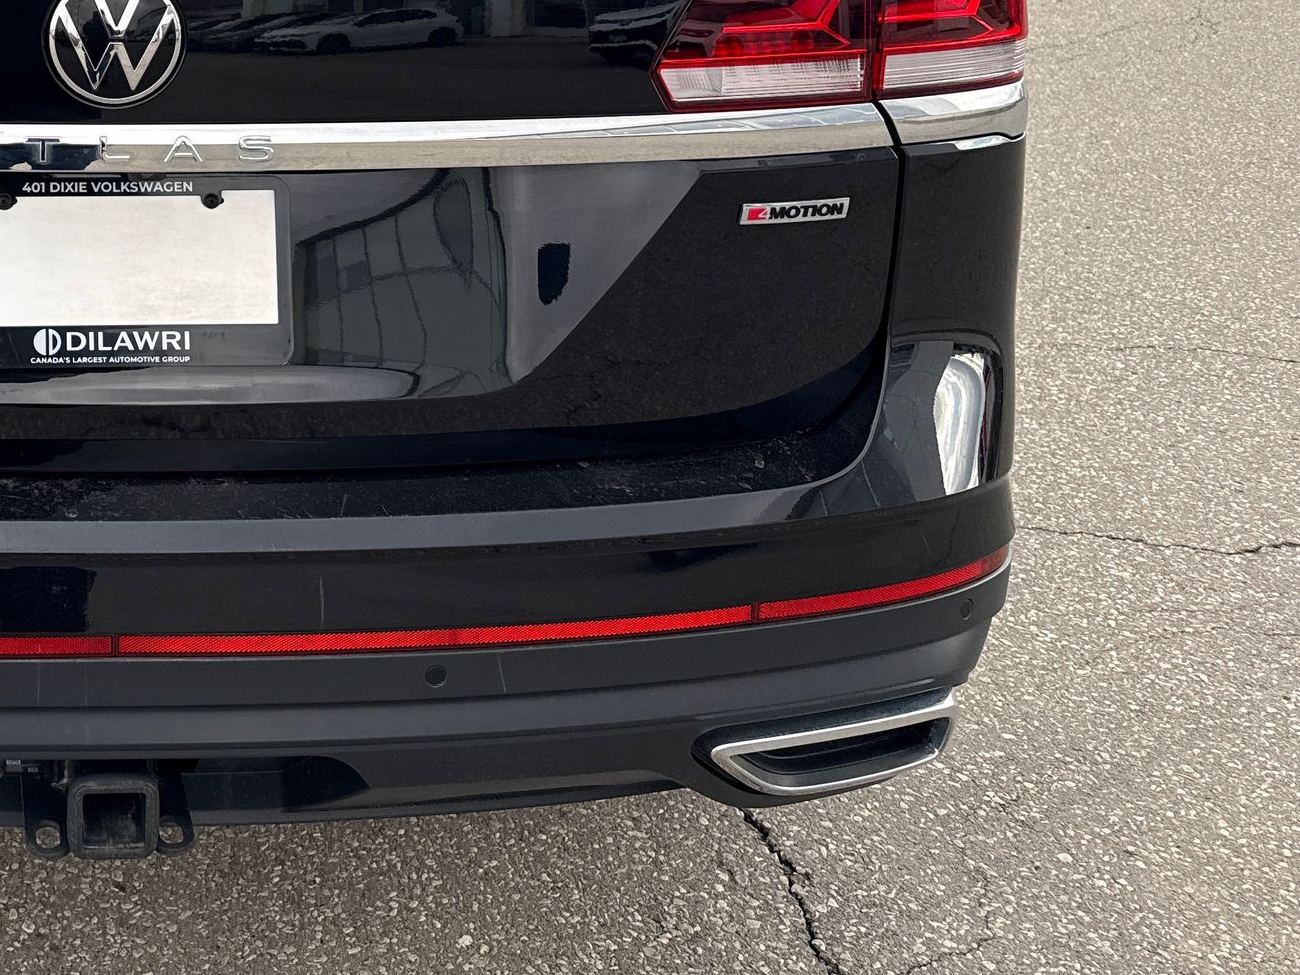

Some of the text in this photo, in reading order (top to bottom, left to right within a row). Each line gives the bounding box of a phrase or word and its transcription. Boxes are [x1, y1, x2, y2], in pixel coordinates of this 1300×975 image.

[21, 181, 193, 193] 401 DIXIE VOLKSWAGEN
[65, 330, 191, 352] DILAWRI
[30, 356, 71, 364] CANADA'S
